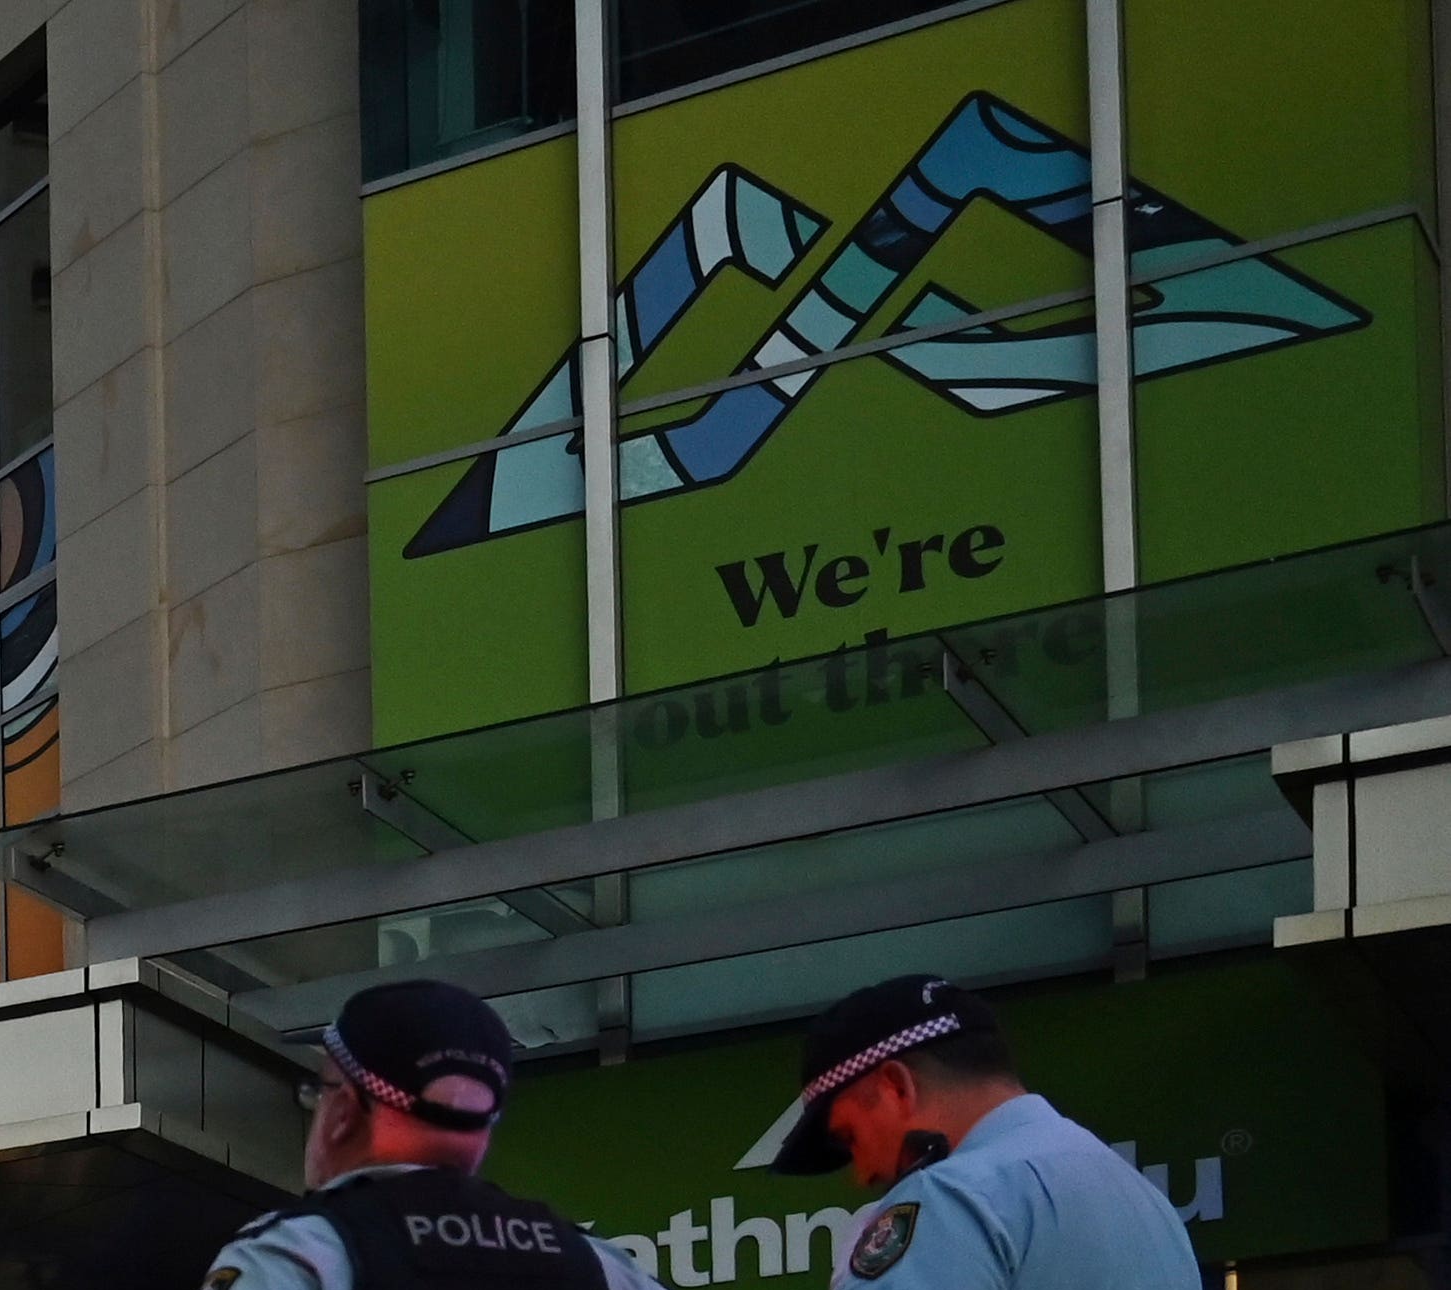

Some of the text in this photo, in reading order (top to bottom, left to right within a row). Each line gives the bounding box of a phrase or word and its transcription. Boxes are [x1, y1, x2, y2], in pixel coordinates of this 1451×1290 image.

[715, 524, 1006, 628] We're
[633, 627, 1107, 749] out thre
[404, 1213, 562, 1254] POLICE
